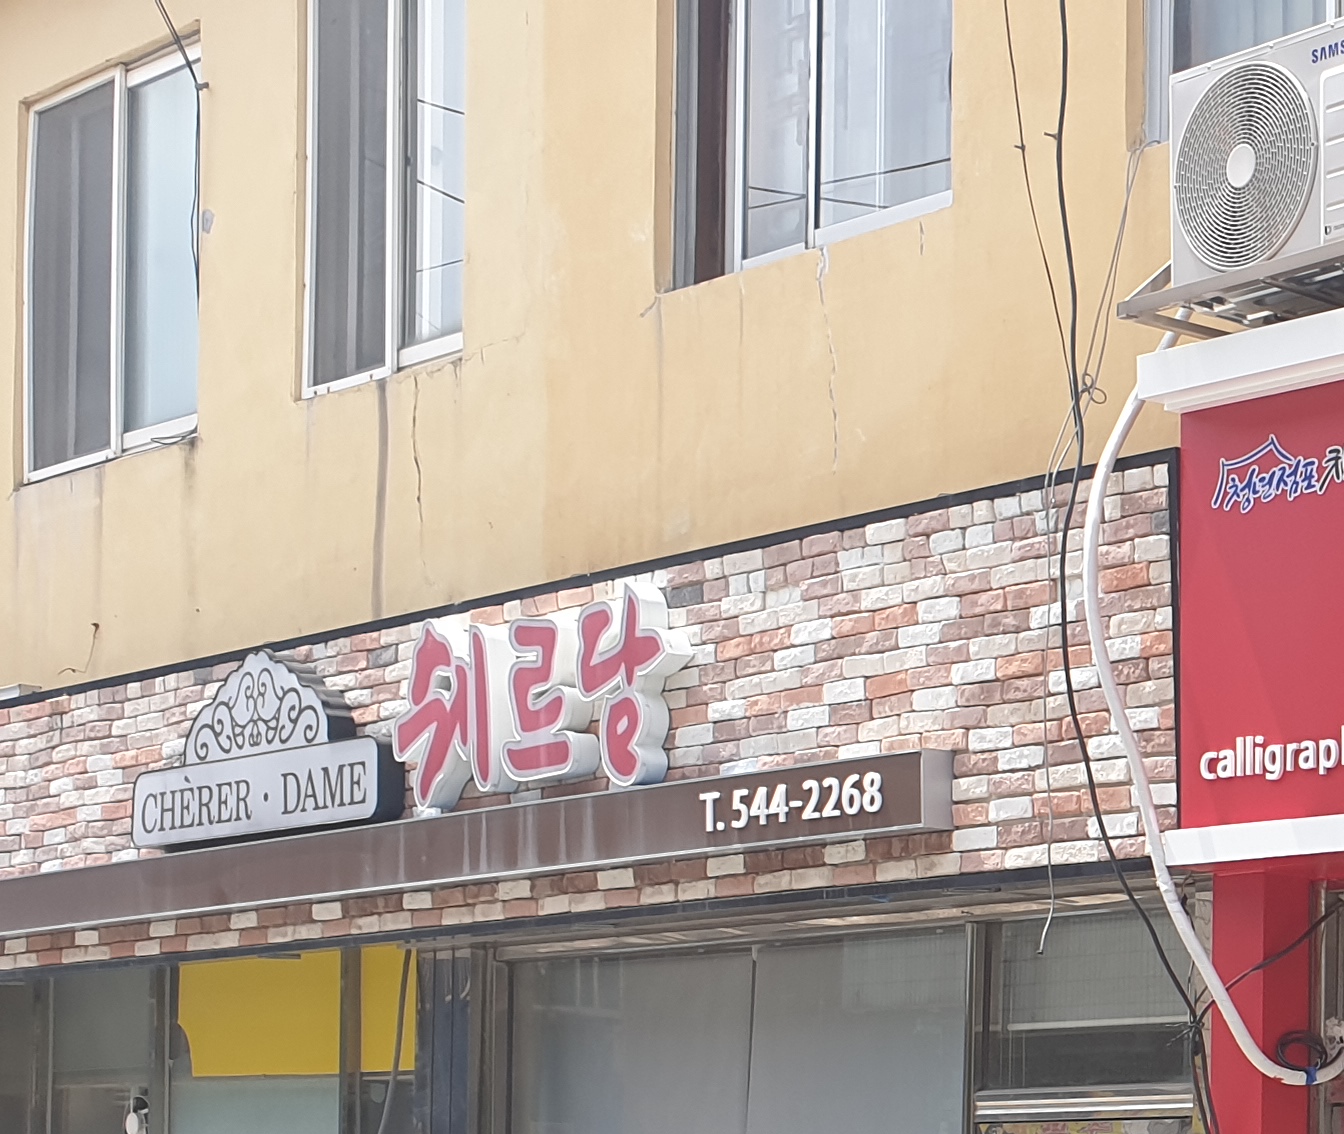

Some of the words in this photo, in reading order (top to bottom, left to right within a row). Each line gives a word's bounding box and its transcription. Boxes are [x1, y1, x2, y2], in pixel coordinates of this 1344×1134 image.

[1222, 456, 1319, 513] 청년점포
[394, 582, 675, 812] 쉐르담
[281, 761, 368, 812] DAME
[701, 790, 726, 832] T.
[730, 771, 884, 828] 544-2268
